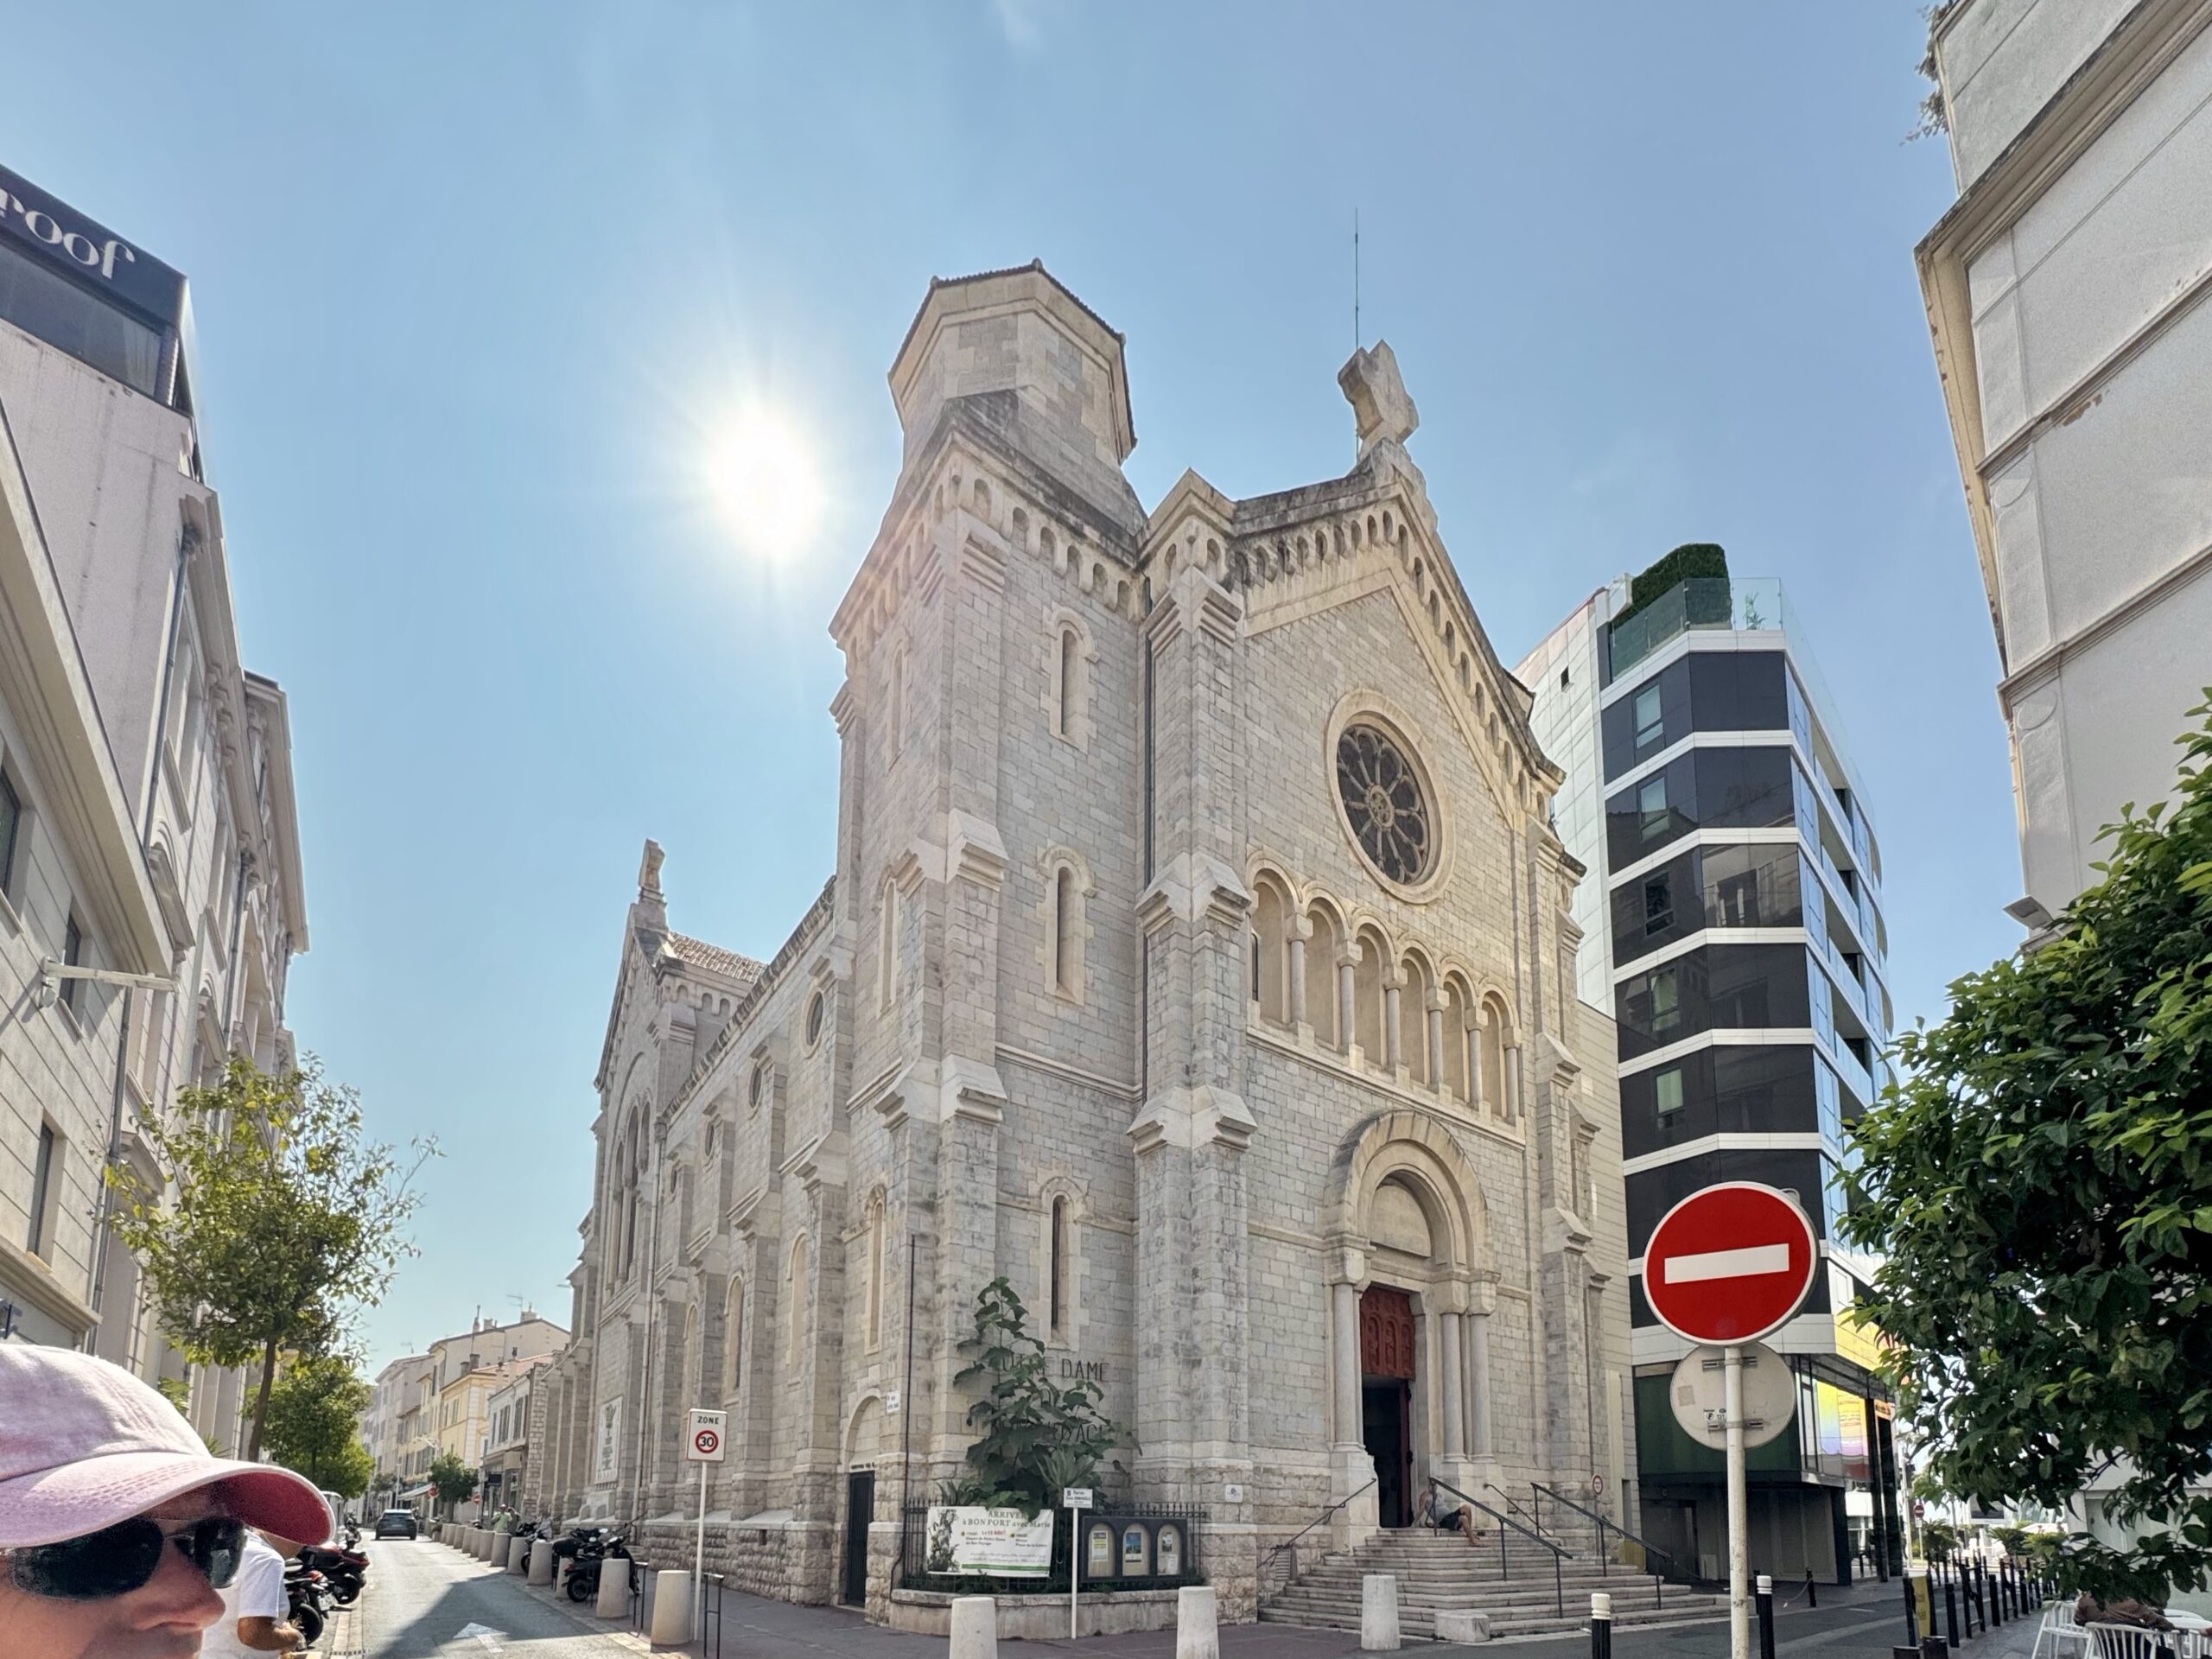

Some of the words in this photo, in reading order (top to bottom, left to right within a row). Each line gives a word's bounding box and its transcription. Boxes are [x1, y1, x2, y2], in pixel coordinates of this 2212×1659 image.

[1062, 1358, 1110, 1382] DAME
[697, 1415, 719, 1425] ZONE
[700, 1436, 715, 1447] 30
